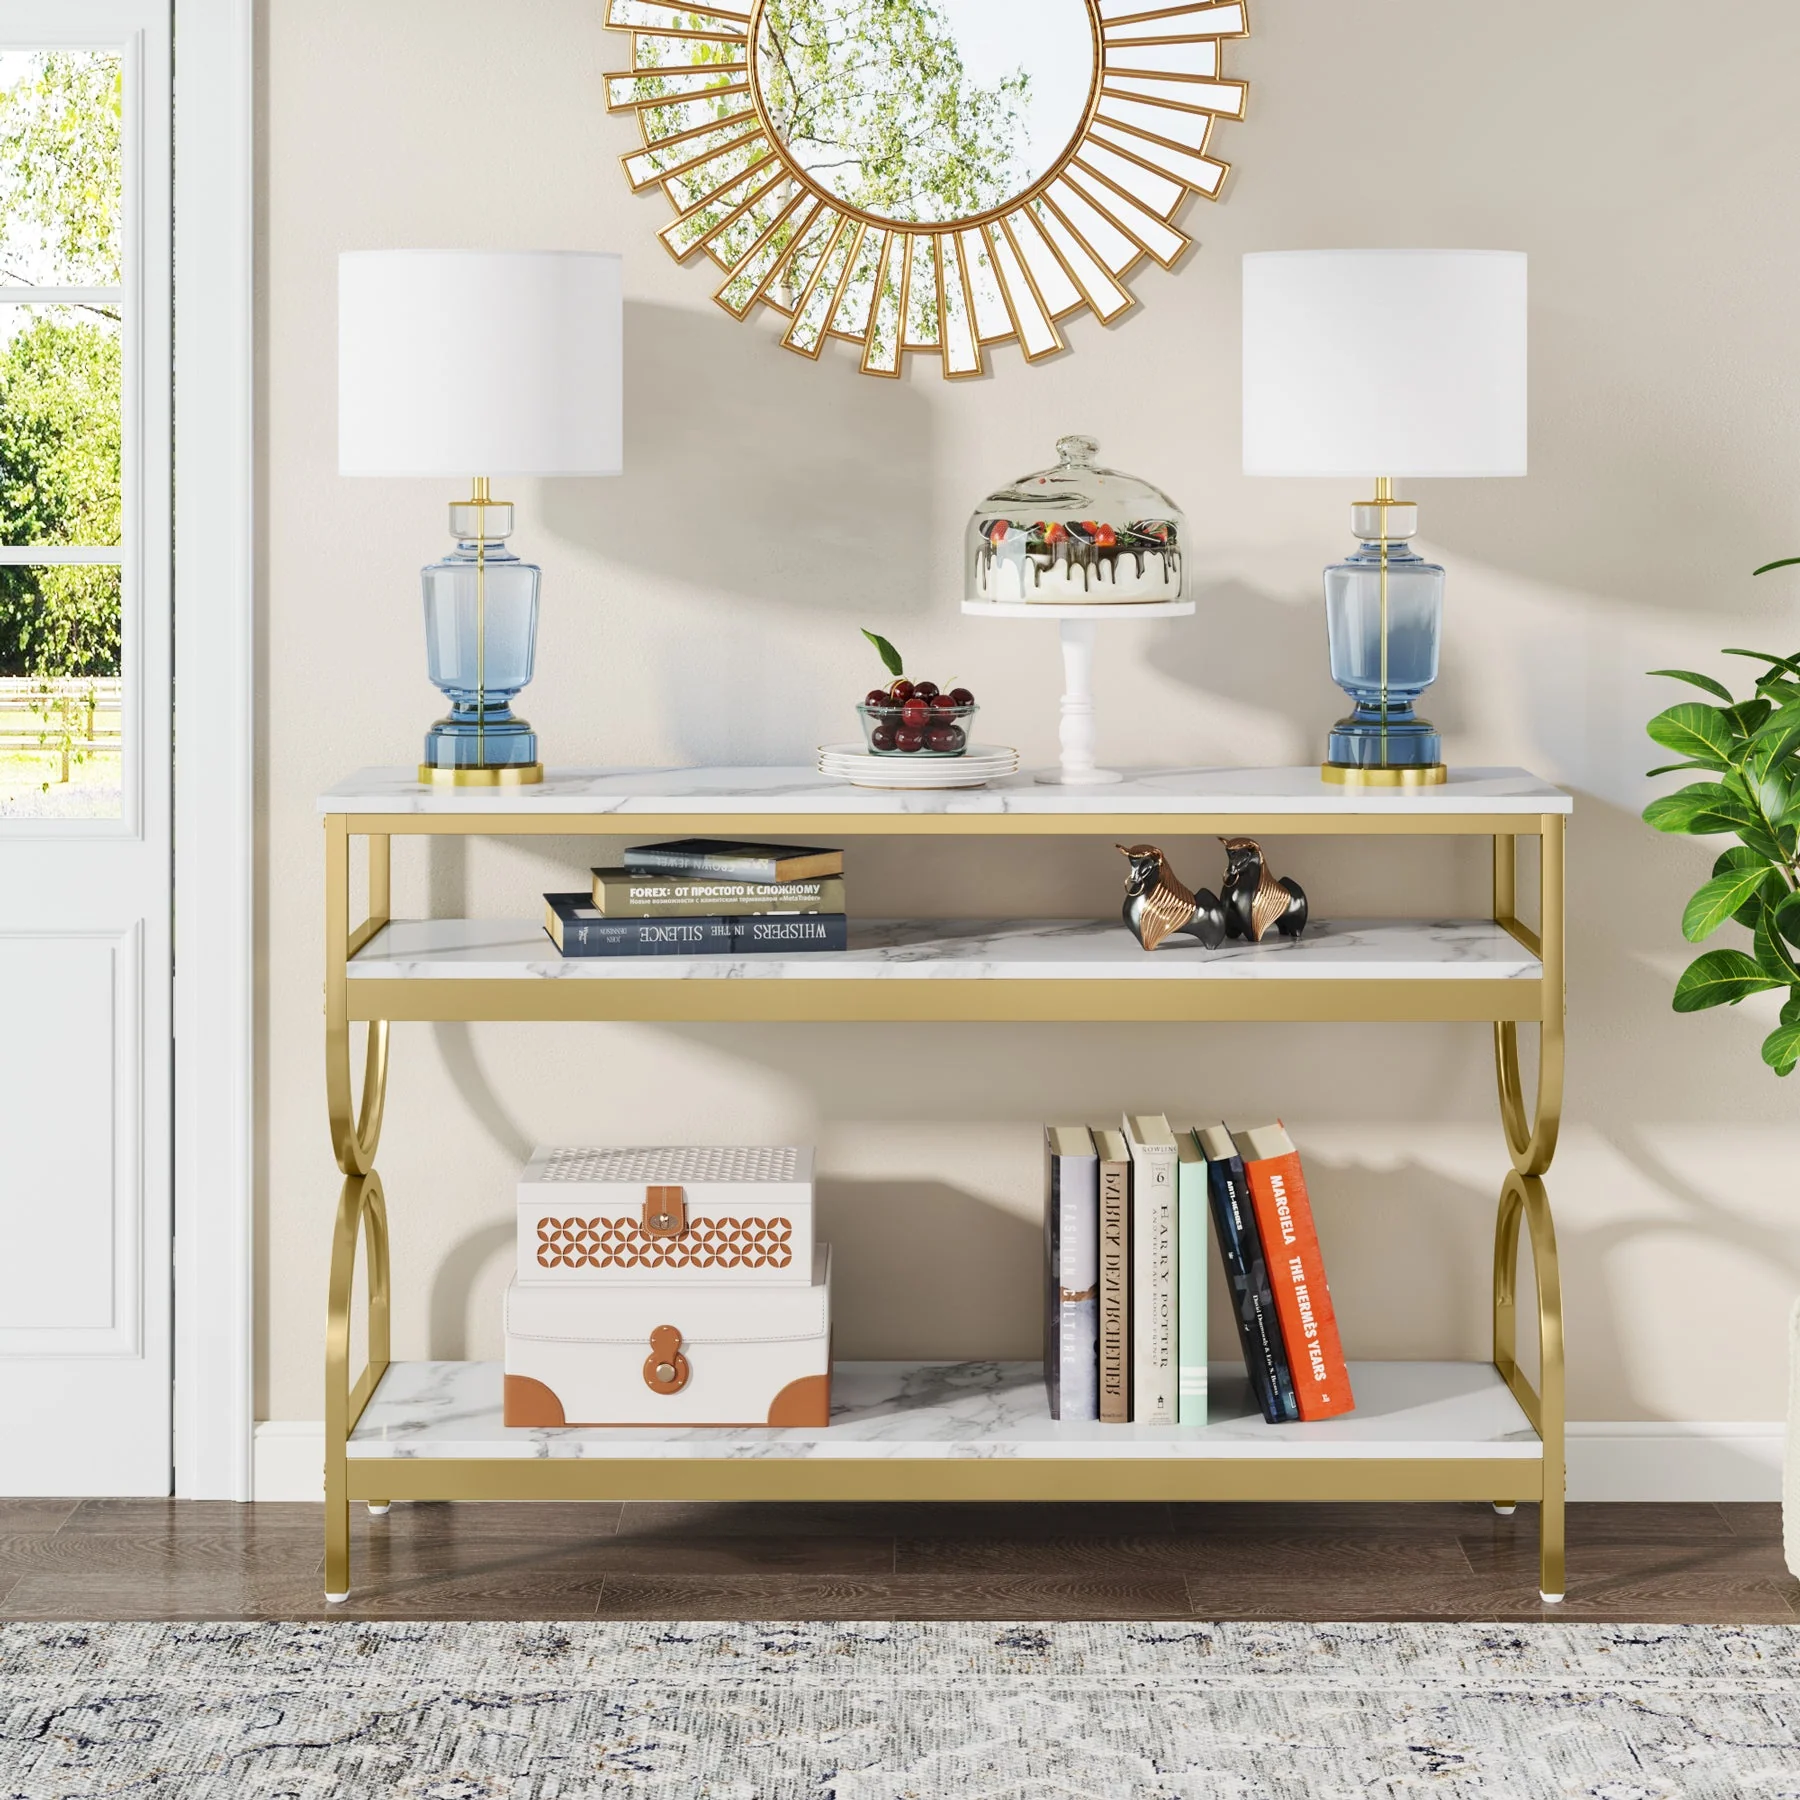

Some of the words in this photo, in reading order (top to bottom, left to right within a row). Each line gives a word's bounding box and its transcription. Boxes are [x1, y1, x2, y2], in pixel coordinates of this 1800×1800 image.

[630, 887, 670, 898] FOREX:
[674, 886, 690, 896] ОТ
[692, 886, 744, 896] ПРОСТОГО
[747, 886, 754, 895] К
[756, 884, 820, 894] СЛОЖНОМУ
[640, 925, 703, 942] SILENCE
[710, 926, 731, 936] THE
[734, 925, 744, 936] IN
[753, 923, 826, 940] WHISPERS
[1156, 1172, 1165, 1182] 6
[1270, 1175, 1296, 1245] MARGIELA
[1064, 1204, 1077, 1276] FASHION
[1160, 1205, 1169, 1284] HARRY
[1288, 1256, 1305, 1284] THE
[1063, 1290, 1076, 1363] CULTURE
[1295, 1284, 1318, 1338] HERMÈS
[1160, 1293, 1169, 1368] POTTER
[1308, 1340, 1327, 1382] YEARS
